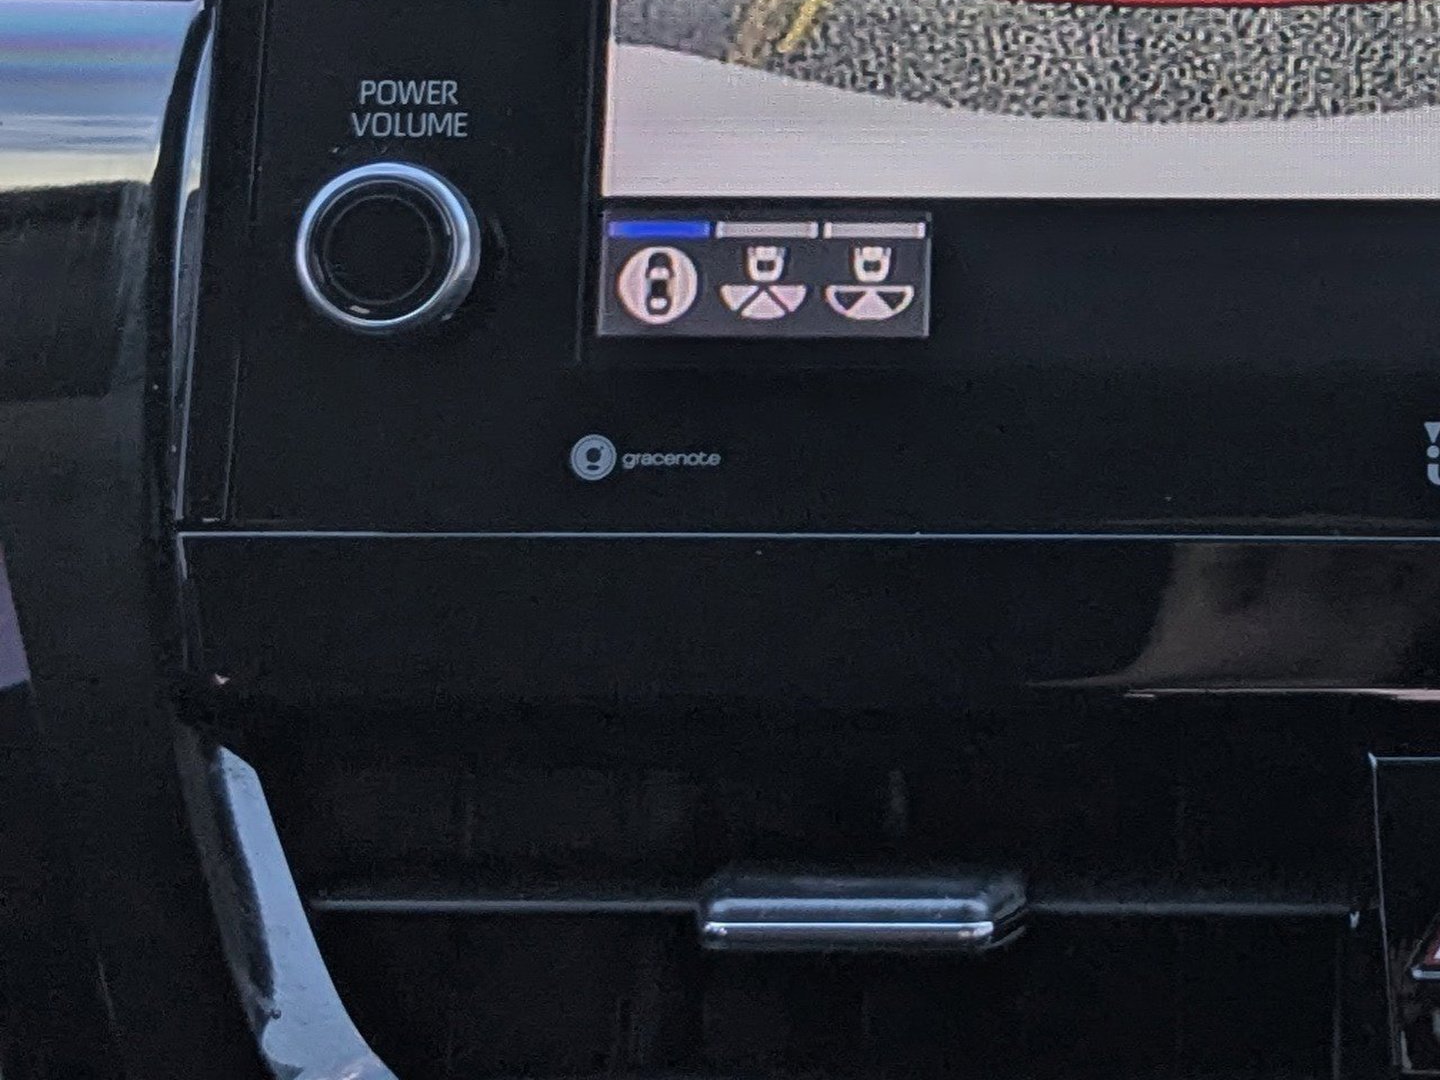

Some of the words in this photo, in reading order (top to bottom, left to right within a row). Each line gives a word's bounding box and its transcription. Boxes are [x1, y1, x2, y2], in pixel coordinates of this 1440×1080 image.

[358, 79, 459, 106] POWER
[350, 111, 469, 138] VOLUME
[621, 451, 722, 470] gracenote
